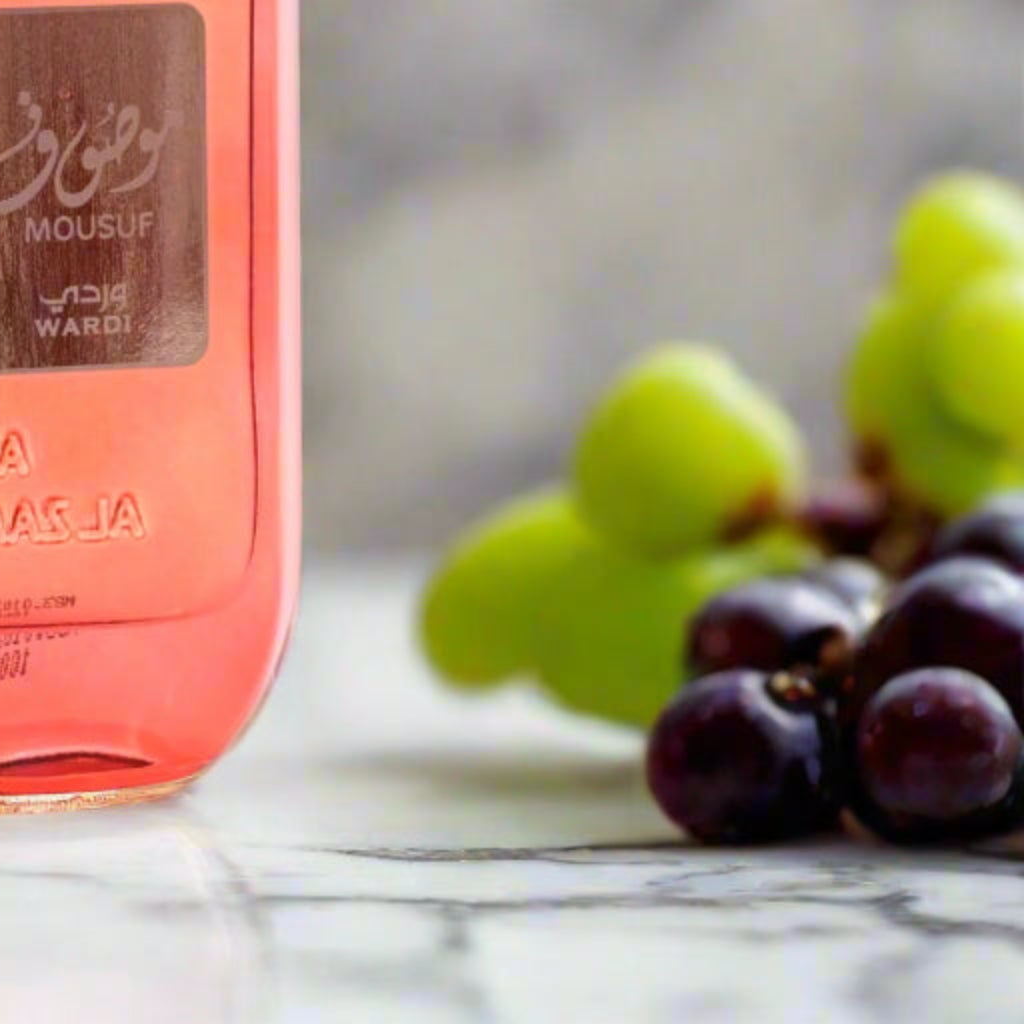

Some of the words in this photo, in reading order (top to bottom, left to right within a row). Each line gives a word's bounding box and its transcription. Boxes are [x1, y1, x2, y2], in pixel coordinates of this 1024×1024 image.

[25, 212, 154, 243] MOUSUF
[39, 282, 127, 313] وردي
[34, 315, 131, 338] WARDI
